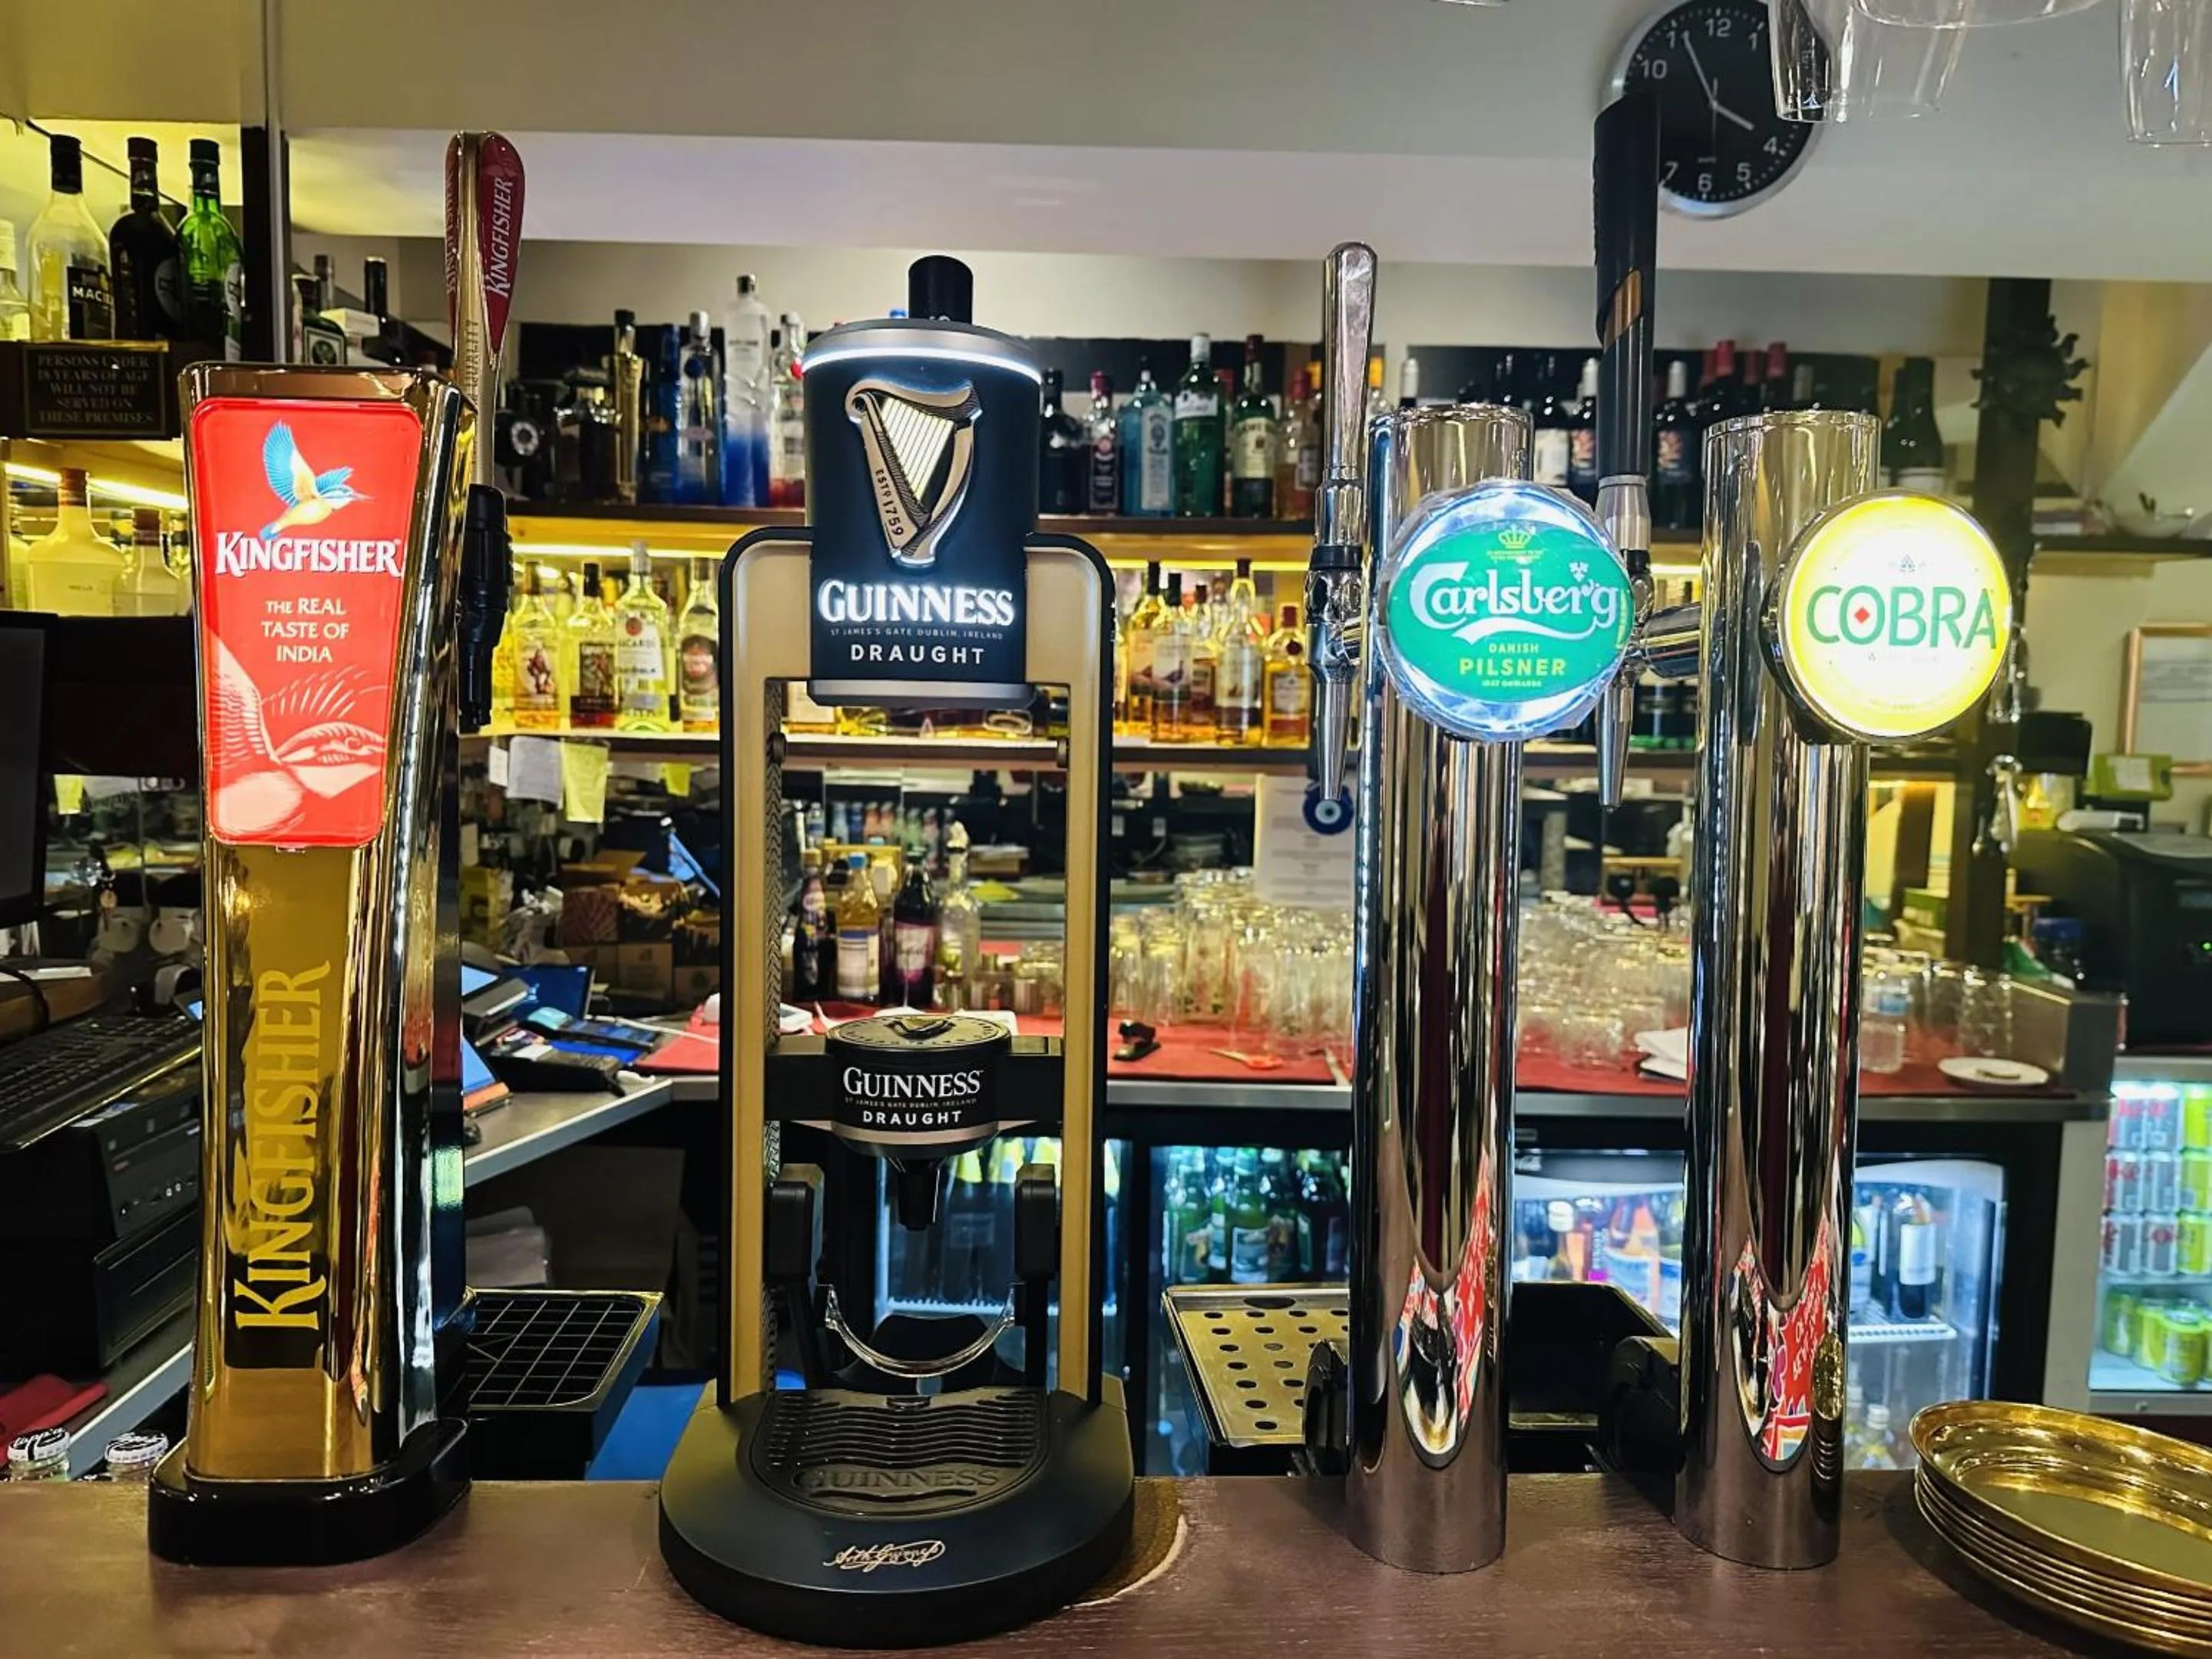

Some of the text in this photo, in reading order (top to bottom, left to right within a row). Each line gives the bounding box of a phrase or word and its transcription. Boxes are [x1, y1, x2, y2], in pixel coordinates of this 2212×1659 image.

[1705, 18, 1731, 37] 12
[1748, 31, 1757, 51] 1
[1641, 59, 1668, 79] 10
[1764, 137, 1777, 154] 4
[1664, 161, 1679, 180] 7
[1737, 163, 1751, 181] 5
[1698, 174, 1712, 192] 6
[484, 177, 513, 298] KINGFISHER
[38, 354, 100, 367] PERSONS
[883, 501, 904, 536] 1759
[215, 530, 402, 578] KINGFISHER
[818, 578, 1016, 626] GUINNESS
[1410, 561, 1618, 630] Carlsberg
[266, 597, 348, 615] THE REAL
[1807, 585, 1996, 649] COBRA
[261, 621, 350, 639] TASTE OF
[885, 627, 912, 636] GATE
[964, 630, 1004, 640] IRELAND
[276, 646, 333, 663] INDIA
[850, 643, 985, 665] DRAUGHT
[1489, 643, 1539, 654] DANISH
[1459, 659, 1567, 676] PILSNER
[842, 1066, 980, 1099] GUINNESS
[862, 1110, 962, 1126] DRAUGHT
[233, 960, 331, 1331] KINGFISHER
[792, 1469, 1000, 1490] GUINNESS
